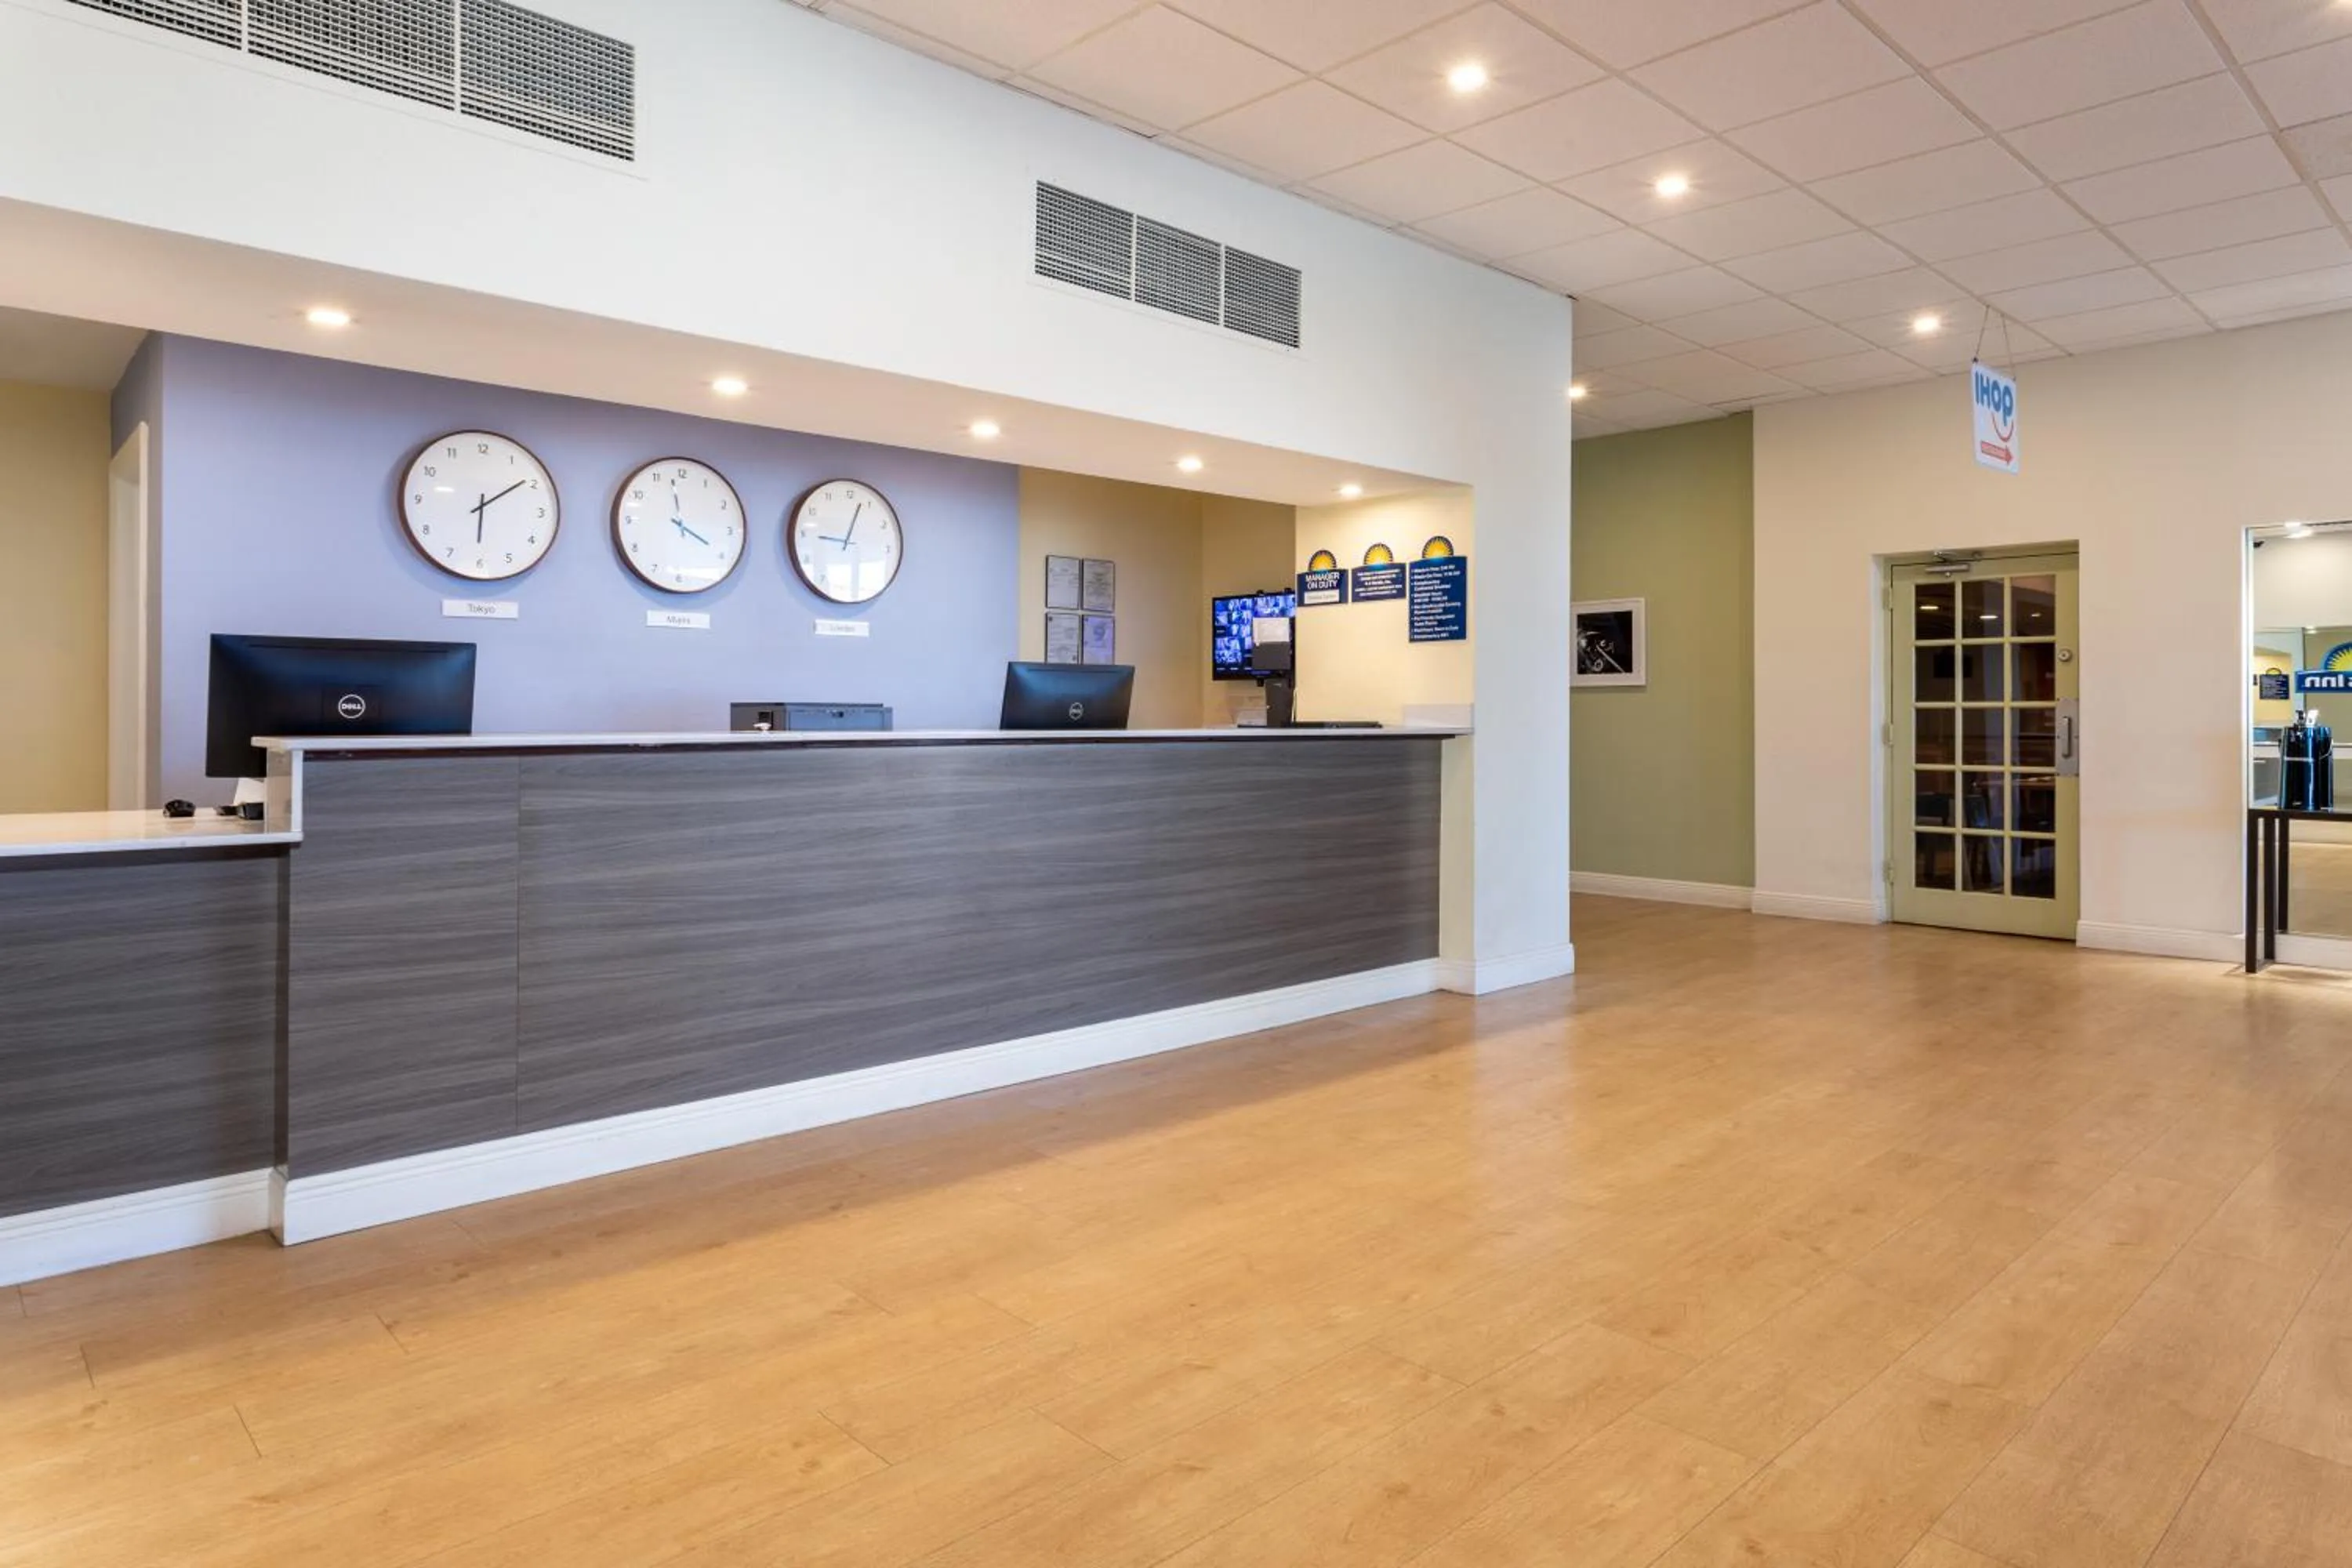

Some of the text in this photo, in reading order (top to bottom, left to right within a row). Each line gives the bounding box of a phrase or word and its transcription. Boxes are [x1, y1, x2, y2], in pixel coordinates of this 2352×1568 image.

[447, 447, 457, 459] 11
[477, 444, 489, 455] 12
[510, 456, 514, 464] 1
[424, 466, 437, 477] 10
[529, 480, 539, 490] 2
[414, 494, 423, 504] 9
[538, 507, 546, 518] 3
[422, 524, 430, 535] 8
[528, 535, 536, 544] 4
[446, 547, 454, 557] 7
[505, 553, 513, 563] 5
[476, 559, 484, 568] 6
[1305, 572, 1340, 582] MANAGER
[1307, 579, 1338, 590] ON DUTY
[467, 603, 496, 615] Tokyo
